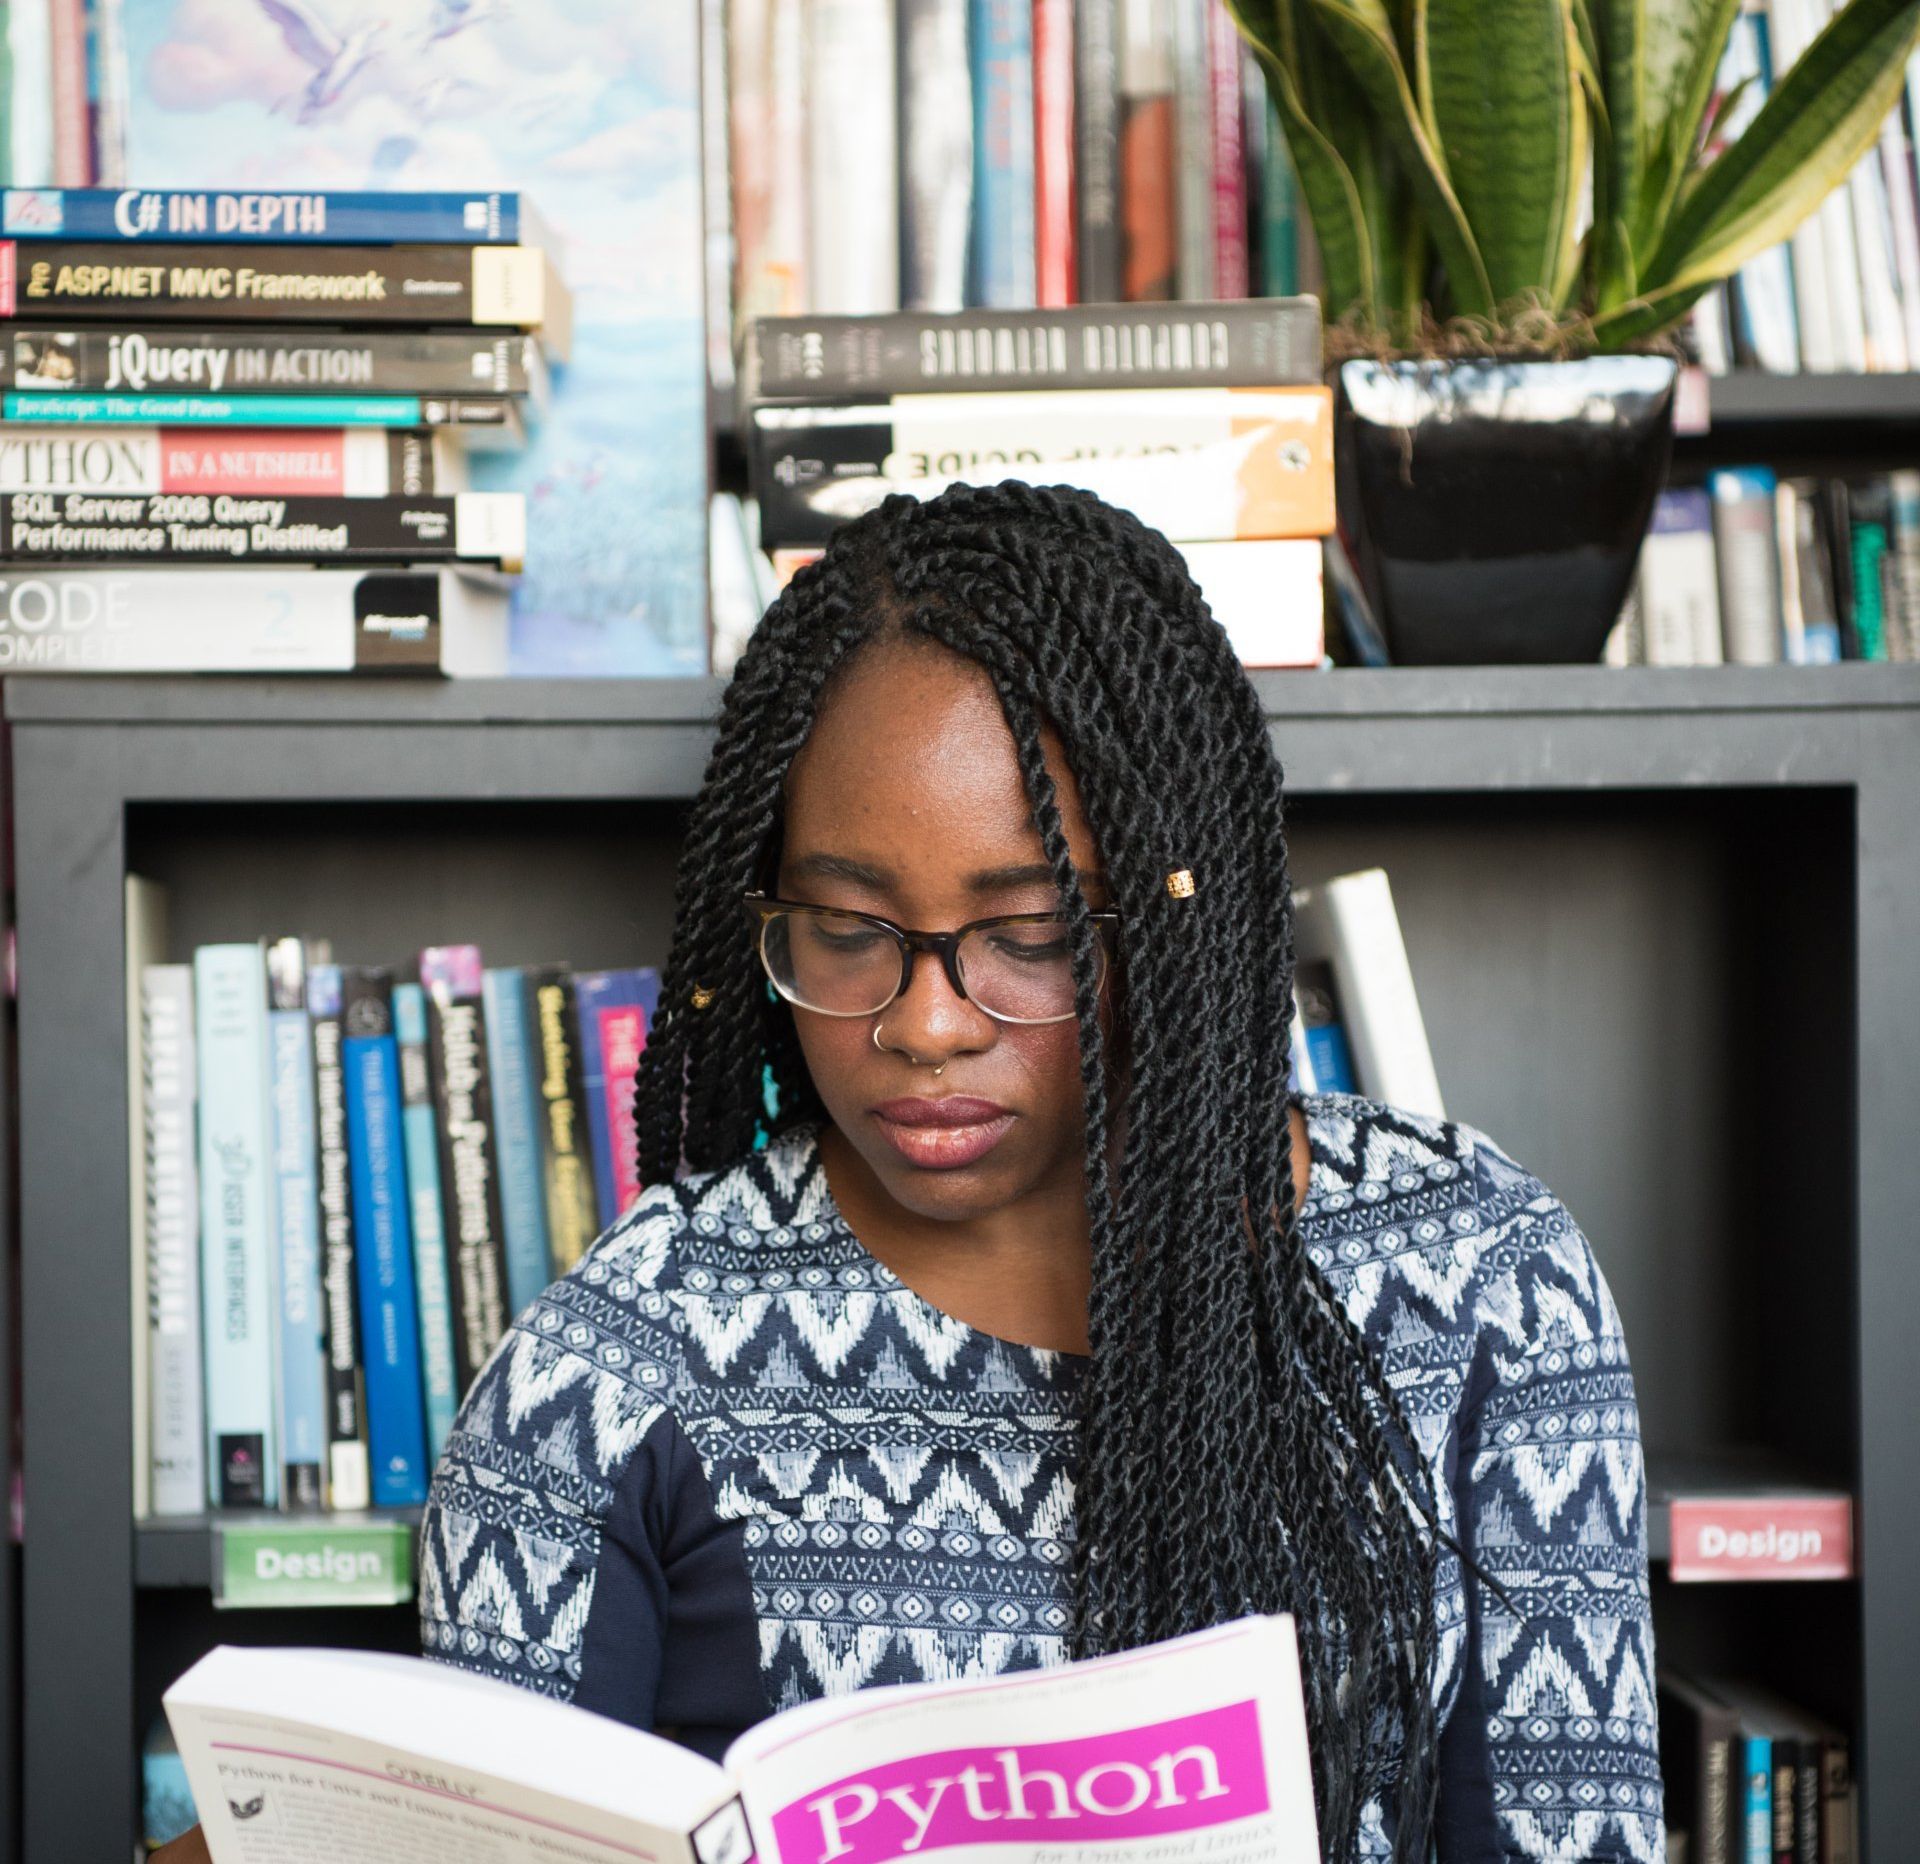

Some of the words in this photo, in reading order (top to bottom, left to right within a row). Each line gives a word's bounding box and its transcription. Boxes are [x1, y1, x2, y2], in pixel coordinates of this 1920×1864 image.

[115, 191, 163, 237] C#
[169, 194, 208, 235] IN
[221, 194, 327, 235] DEPTH
[55, 265, 167, 299] ASP.NET
[170, 266, 232, 298] MVC
[235, 268, 387, 301] Framework
[107, 334, 230, 390] jQuery
[234, 349, 265, 381] IN
[270, 348, 374, 382] ACTION
[105, 397, 139, 417] The
[188, 399, 232, 419] Parts
[168, 449, 196, 478] IN
[198, 450, 219, 478] A
[221, 450, 338, 479] NUTSHELL
[10, 494, 61, 521] SQL
[64, 495, 146, 523] Server
[148, 495, 210, 522] 2008
[213, 496, 286, 527] Query
[10, 523, 165, 552] Performance
[168, 525, 248, 556] Tuning
[250, 523, 348, 552] Distilled
[1698, 1525, 1822, 1562] Design
[255, 1545, 382, 1582] Design
[806, 1742, 1231, 1864] Python
